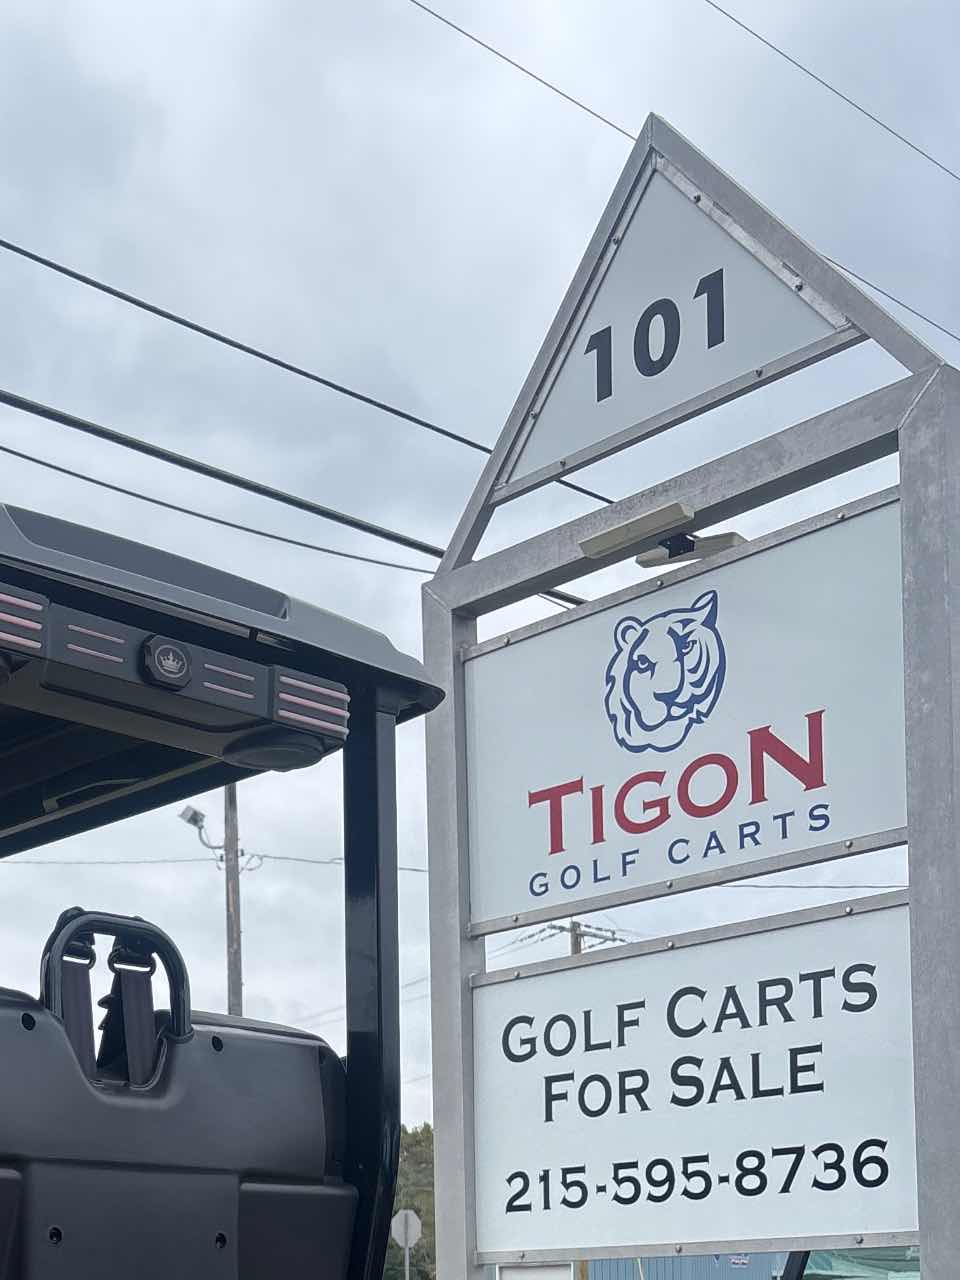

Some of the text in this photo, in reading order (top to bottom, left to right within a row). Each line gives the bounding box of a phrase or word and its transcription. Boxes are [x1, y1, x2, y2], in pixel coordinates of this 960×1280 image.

[583, 267, 726, 403] 101
[528, 709, 827, 856] TIGON
[528, 803, 831, 898] GOLF CARTS
[501, 963, 879, 1064] GOLF CARTS
[543, 1041, 825, 1123] FOR SALE
[505, 1138, 890, 1215] 215-595-8736
